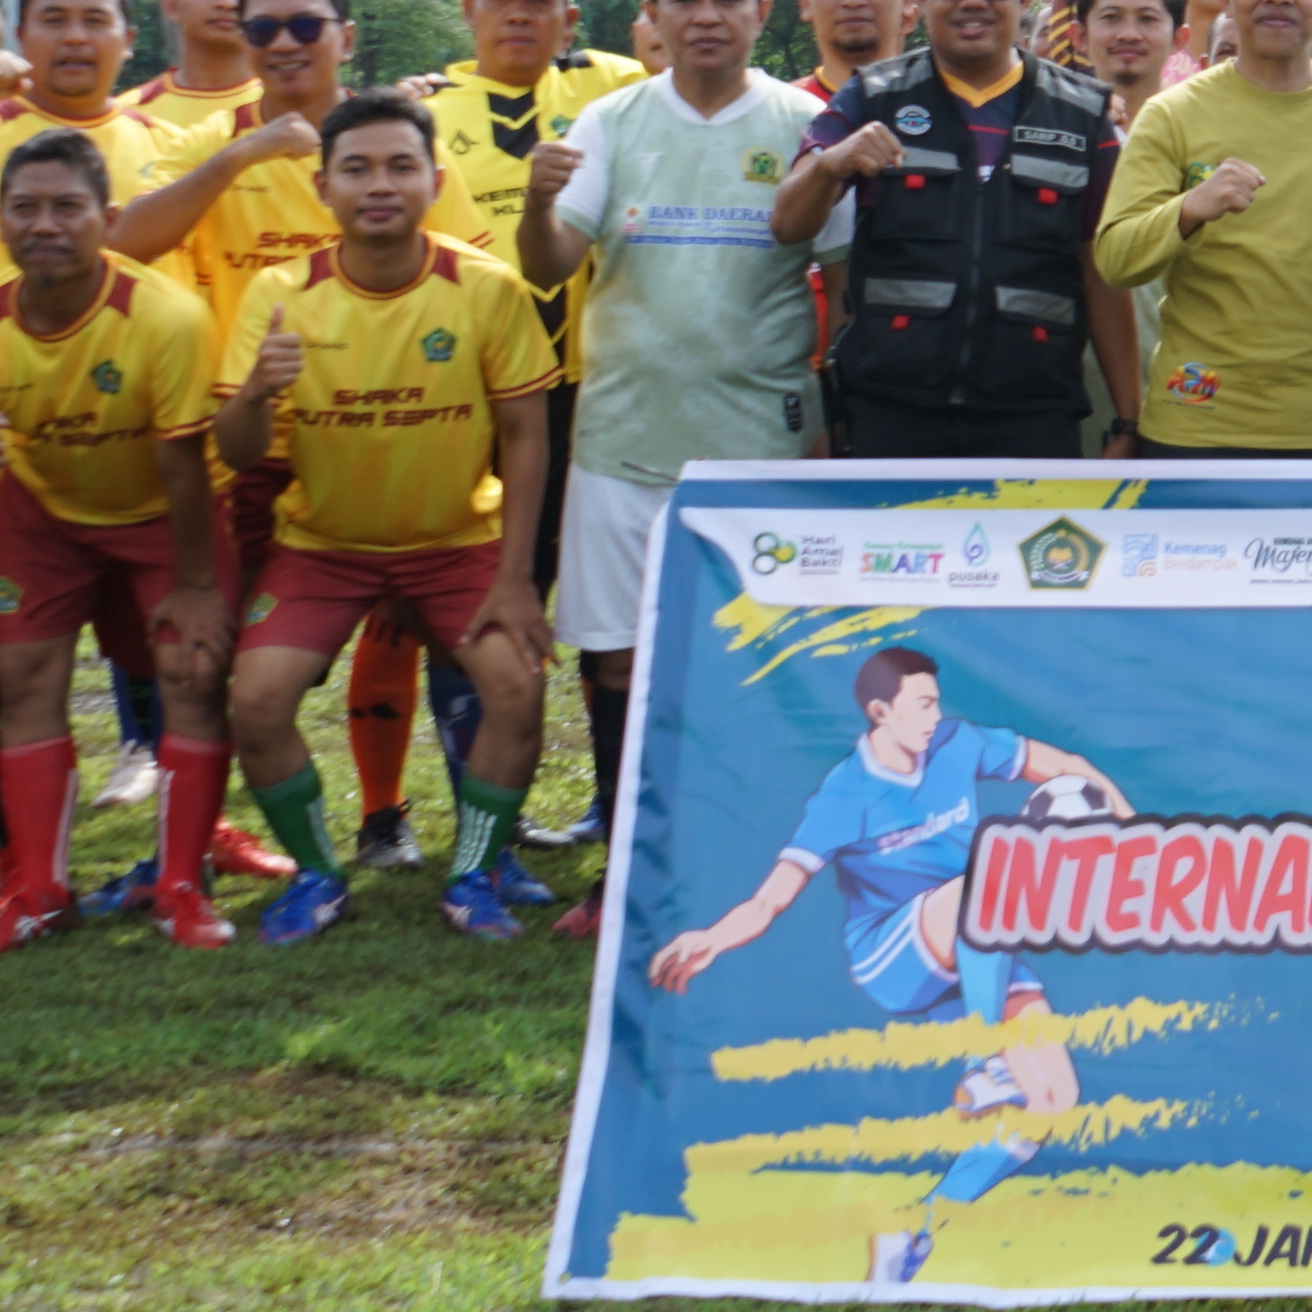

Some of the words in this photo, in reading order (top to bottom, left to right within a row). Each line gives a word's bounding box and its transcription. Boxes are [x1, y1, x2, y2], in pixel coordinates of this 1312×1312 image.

[1164, 542, 1227, 558] Kemenag
[860, 553, 945, 574] SMART
[949, 569, 1000, 583] pusaka
[1150, 1224, 1221, 1266] 22
